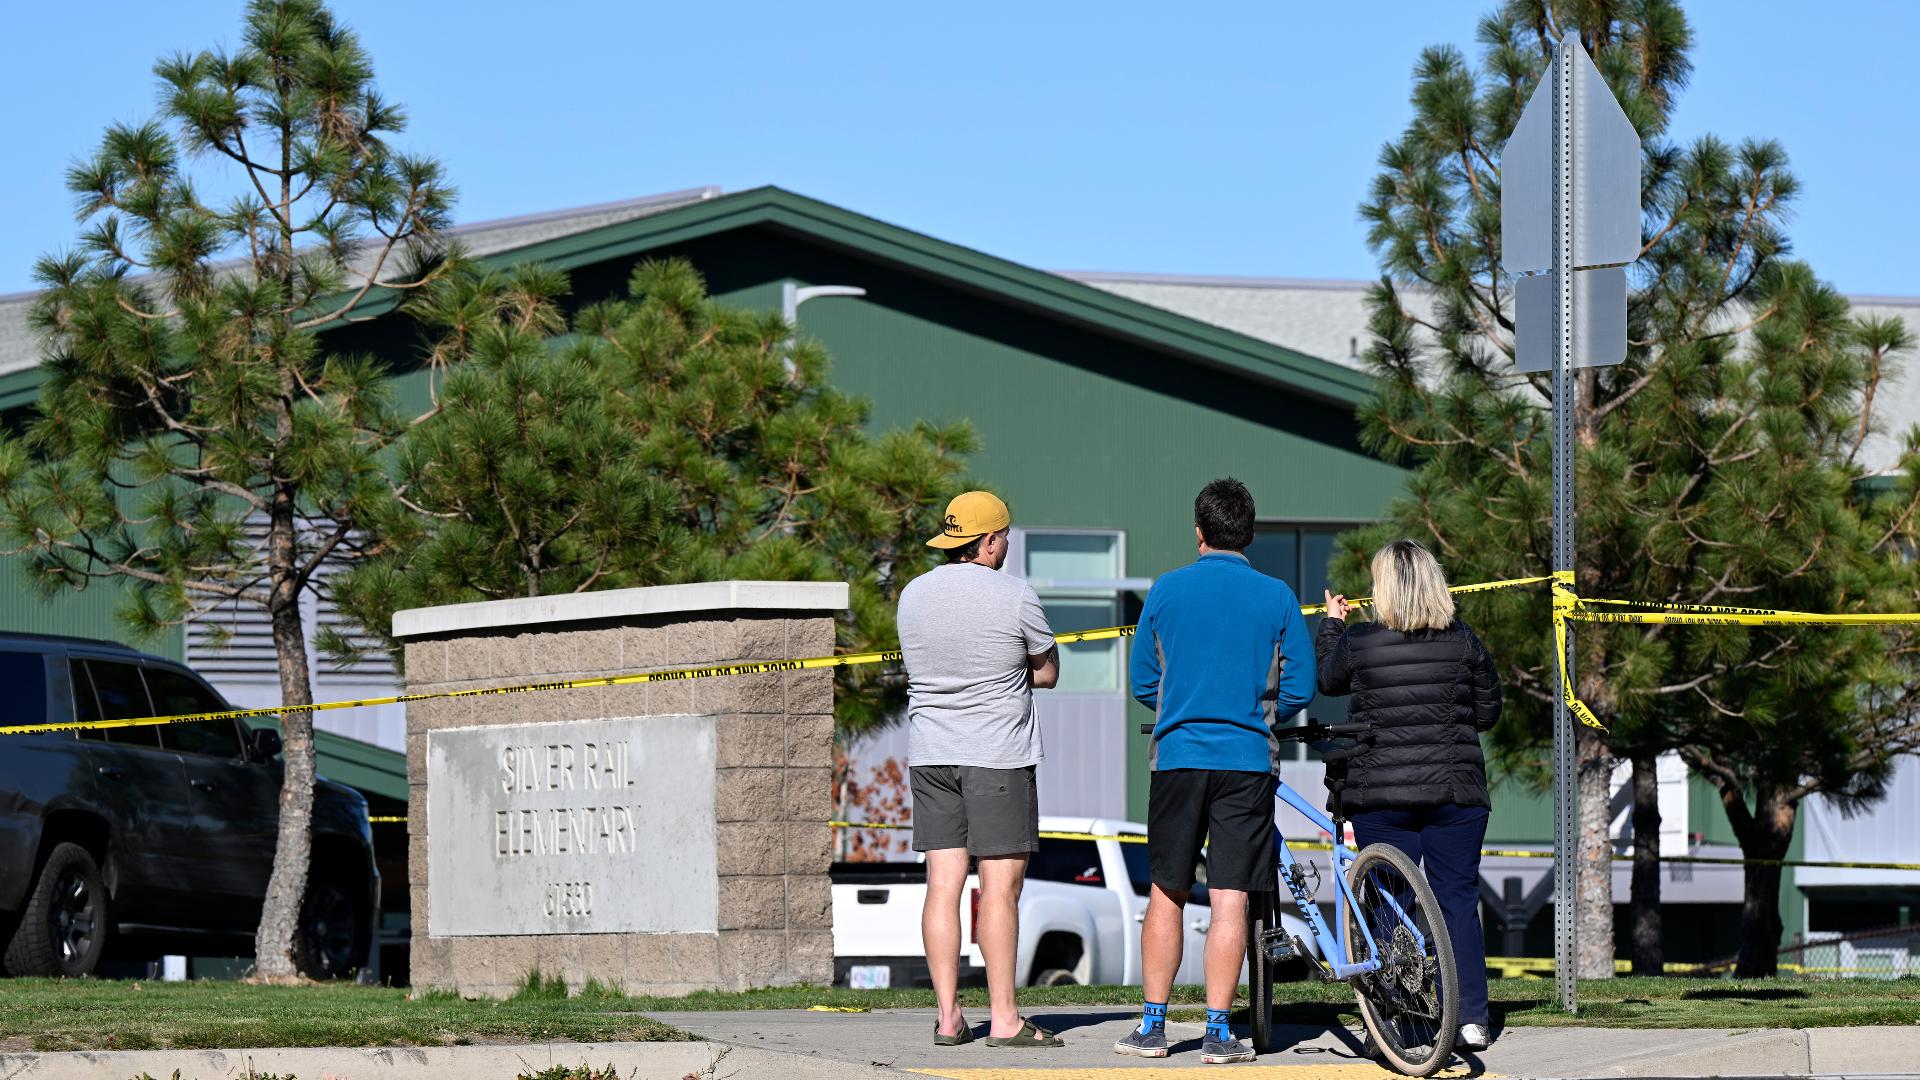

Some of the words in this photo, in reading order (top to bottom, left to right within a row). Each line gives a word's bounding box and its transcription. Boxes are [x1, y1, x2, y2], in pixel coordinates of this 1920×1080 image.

[501, 744, 575, 795] SILVER
[584, 741, 635, 790] RAIL
[495, 804, 642, 857] ELEMENTARY
